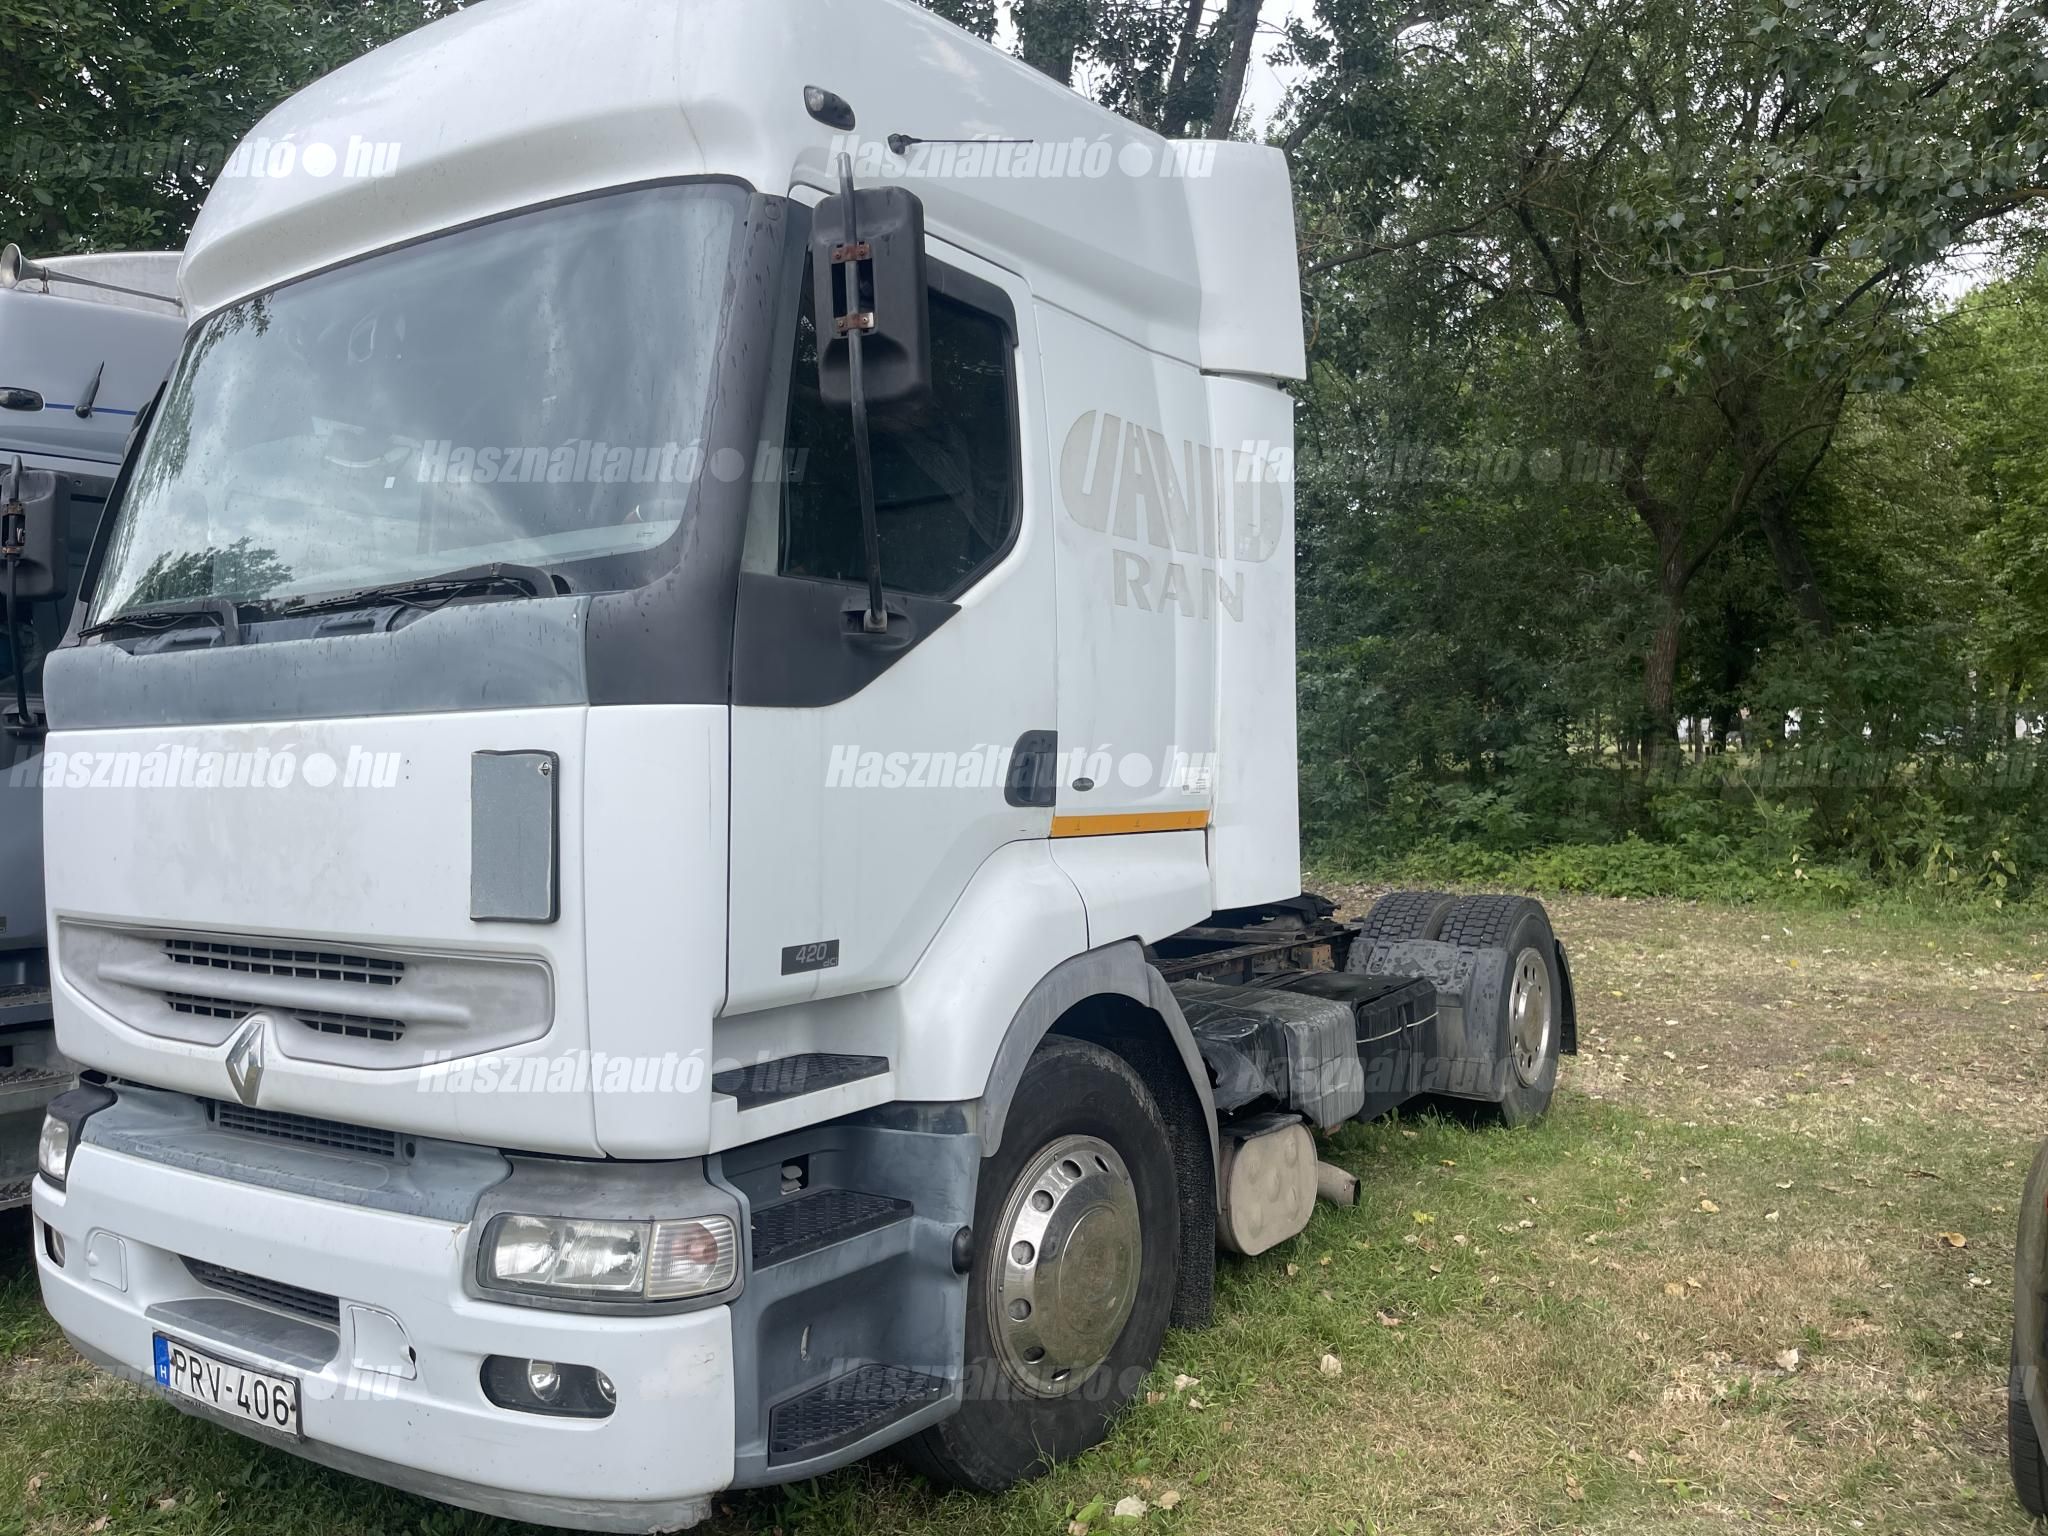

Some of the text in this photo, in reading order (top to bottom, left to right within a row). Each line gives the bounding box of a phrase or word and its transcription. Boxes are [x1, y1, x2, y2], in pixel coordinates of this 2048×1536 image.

[1112, 548, 1244, 622] RAN
[796, 943, 828, 964] 420
[160, 1365, 167, 1379] H
[172, 1348, 289, 1426] PRV-406
